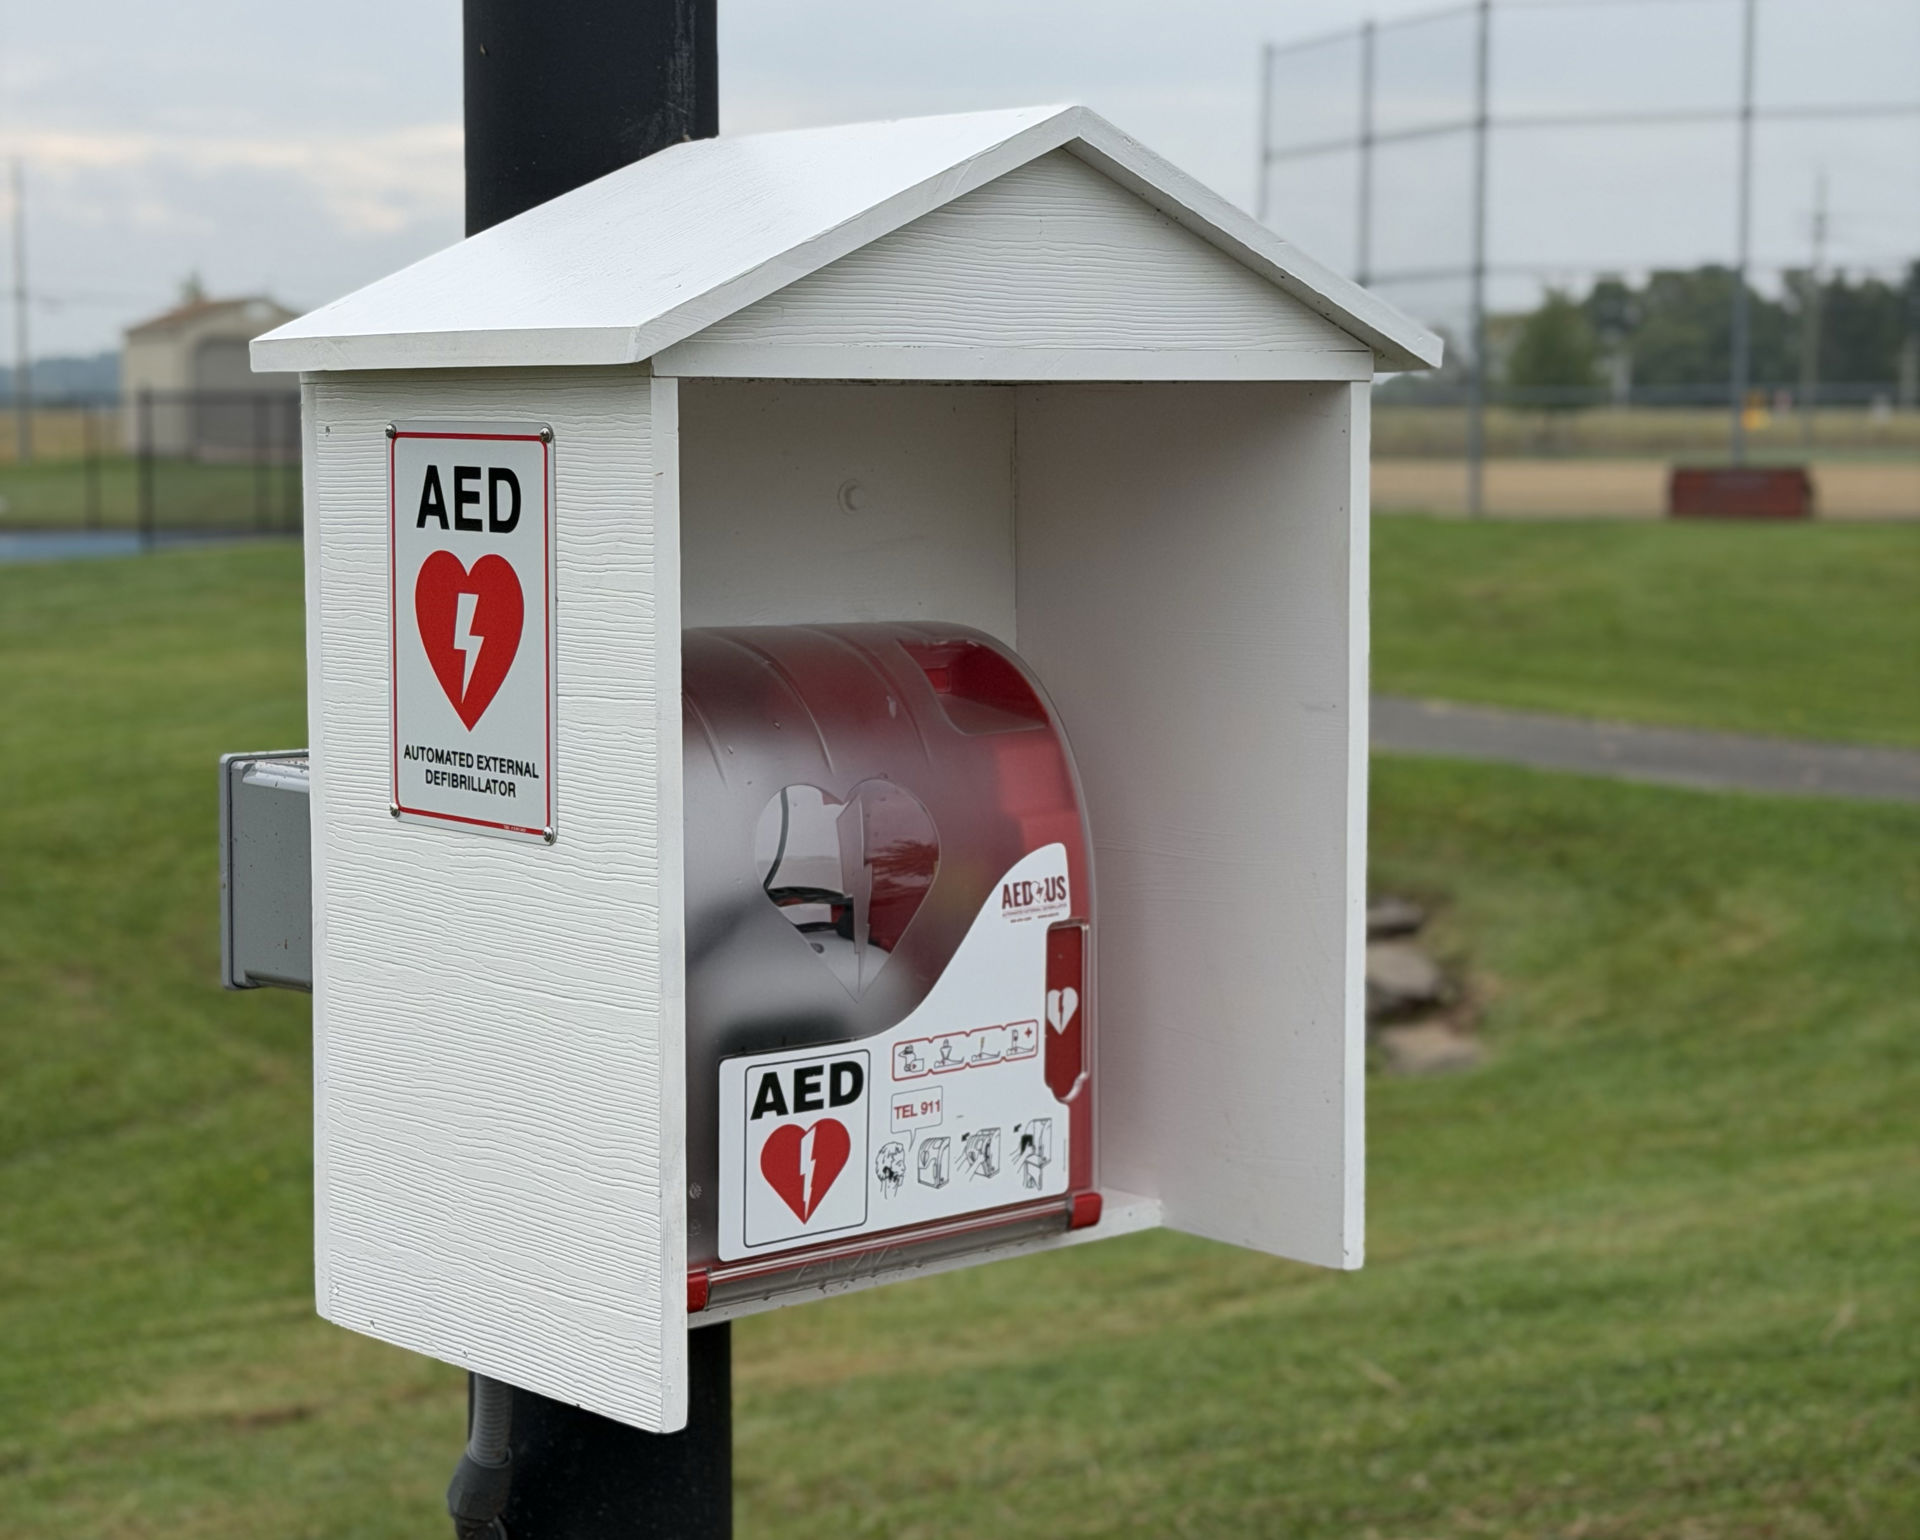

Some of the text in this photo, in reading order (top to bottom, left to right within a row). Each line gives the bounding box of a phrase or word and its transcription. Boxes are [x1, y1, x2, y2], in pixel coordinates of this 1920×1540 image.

[416, 464, 522, 534] AED
[403, 744, 539, 779] AUTOMATED EXTERNAL
[425, 768, 516, 798] DEFIBRILLATOR
[750, 1060, 864, 1121] AED
[893, 1099, 941, 1120] TEL 911
